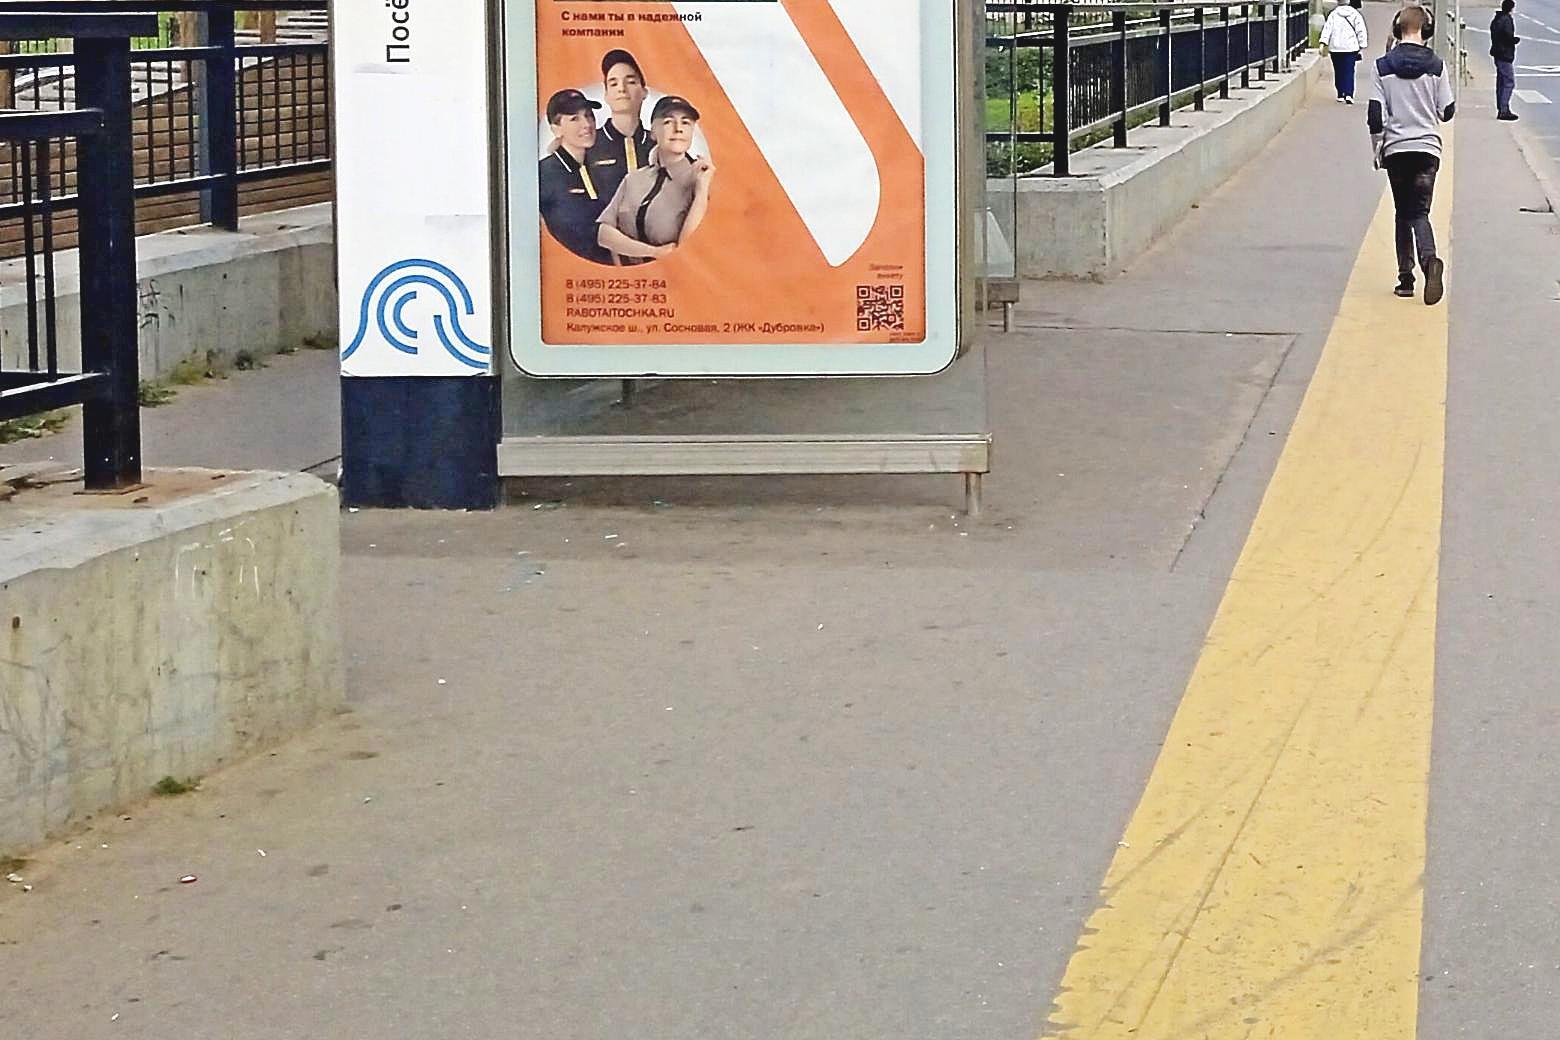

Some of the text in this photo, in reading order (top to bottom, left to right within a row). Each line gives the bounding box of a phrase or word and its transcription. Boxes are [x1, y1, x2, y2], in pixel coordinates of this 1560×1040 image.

[561, 11, 571, 22] С
[572, 12, 606, 22] нами
[607, 12, 625, 22] ты
[638, 11, 702, 23] надежной
[561, 27, 625, 38] компании
[566, 279, 574, 289] 8
[576, 279, 605, 290] (495)
[565, 294, 574, 304] 8
[723, 323, 731, 333] 2
